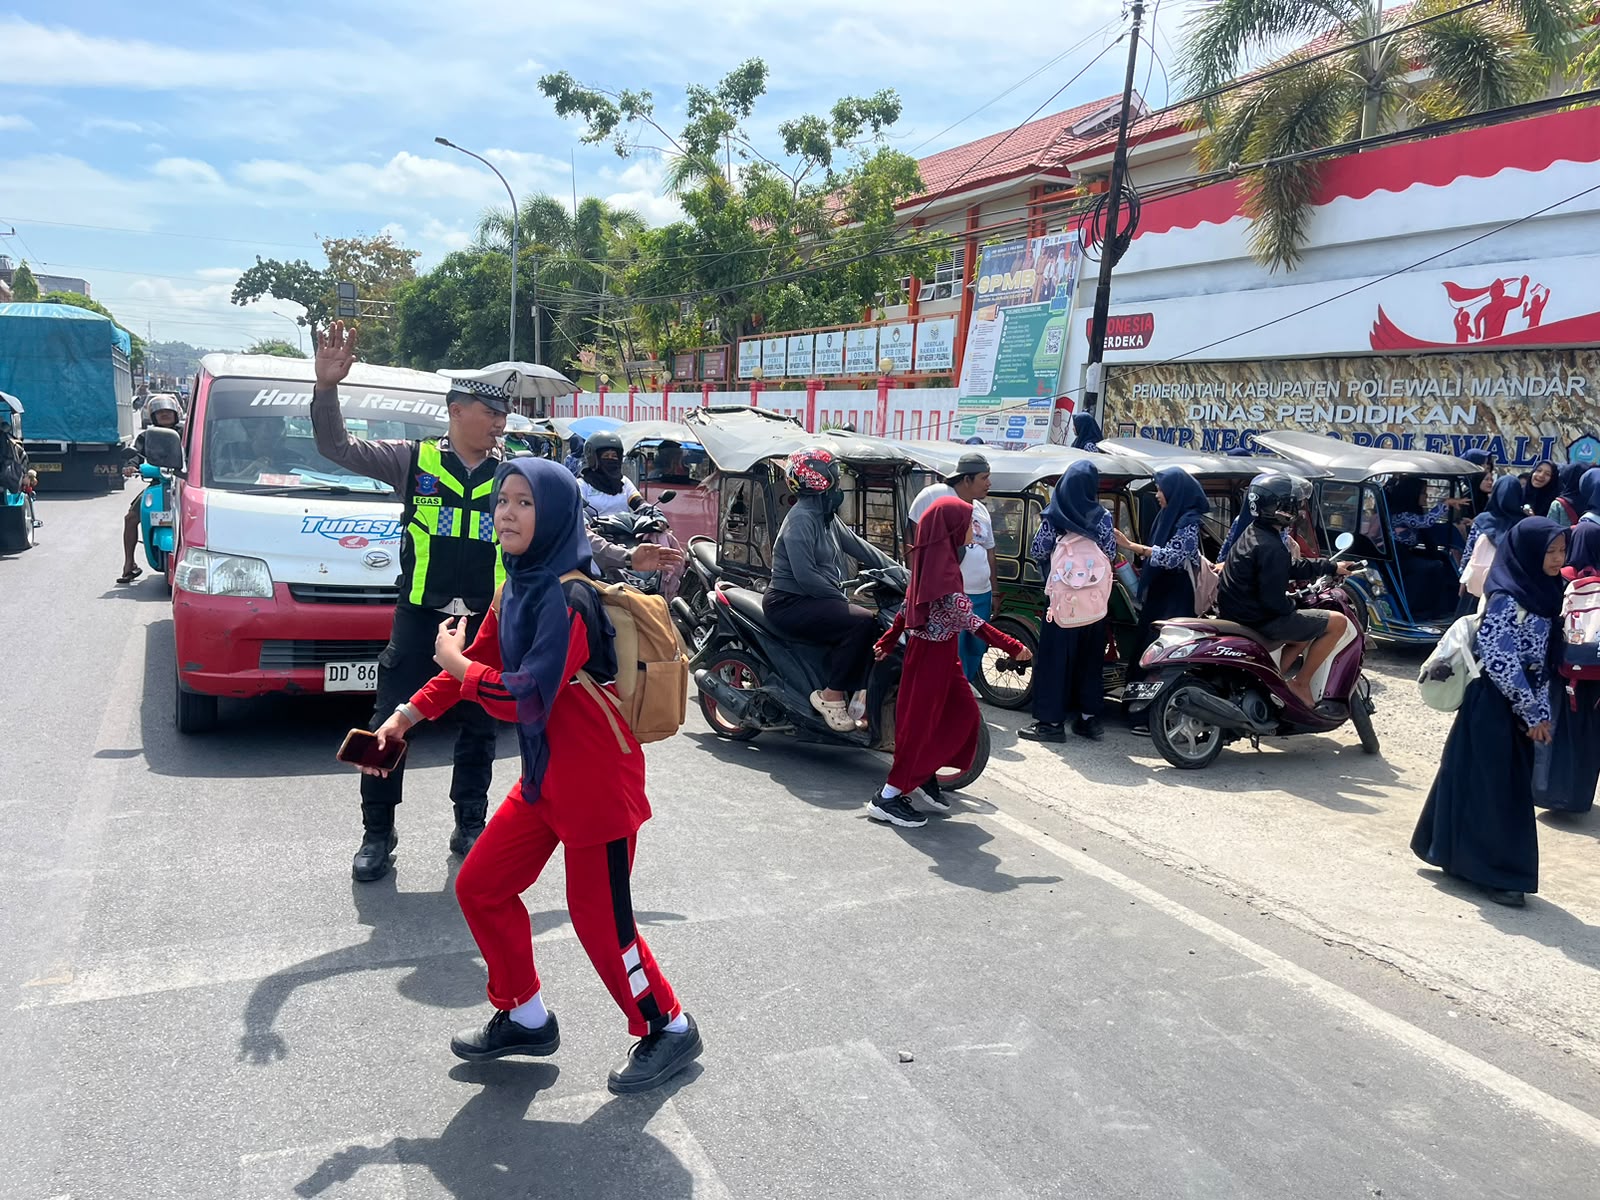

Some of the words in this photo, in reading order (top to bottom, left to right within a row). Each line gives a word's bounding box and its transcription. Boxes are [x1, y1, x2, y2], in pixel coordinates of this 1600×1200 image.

[978, 269, 1036, 294] SPMB
[1087, 315, 1153, 337] IONESIA
[1103, 335, 1144, 348] ERDEKA
[1132, 383, 1226, 398] PEMERINTAH
[1232, 381, 1340, 398] KABUPATEN
[1347, 378, 1462, 398] POLEWALI
[1471, 376, 1586, 397] MANDAR
[250, 389, 352, 407] Hona
[359, 393, 451, 423] Racing
[1188, 404, 1266, 422] DINAS
[1275, 405, 1477, 425] PENDIDIKAN
[1140, 426, 1195, 448] SMP
[328, 665, 349, 681] DD
[357, 665, 376, 681] 86
